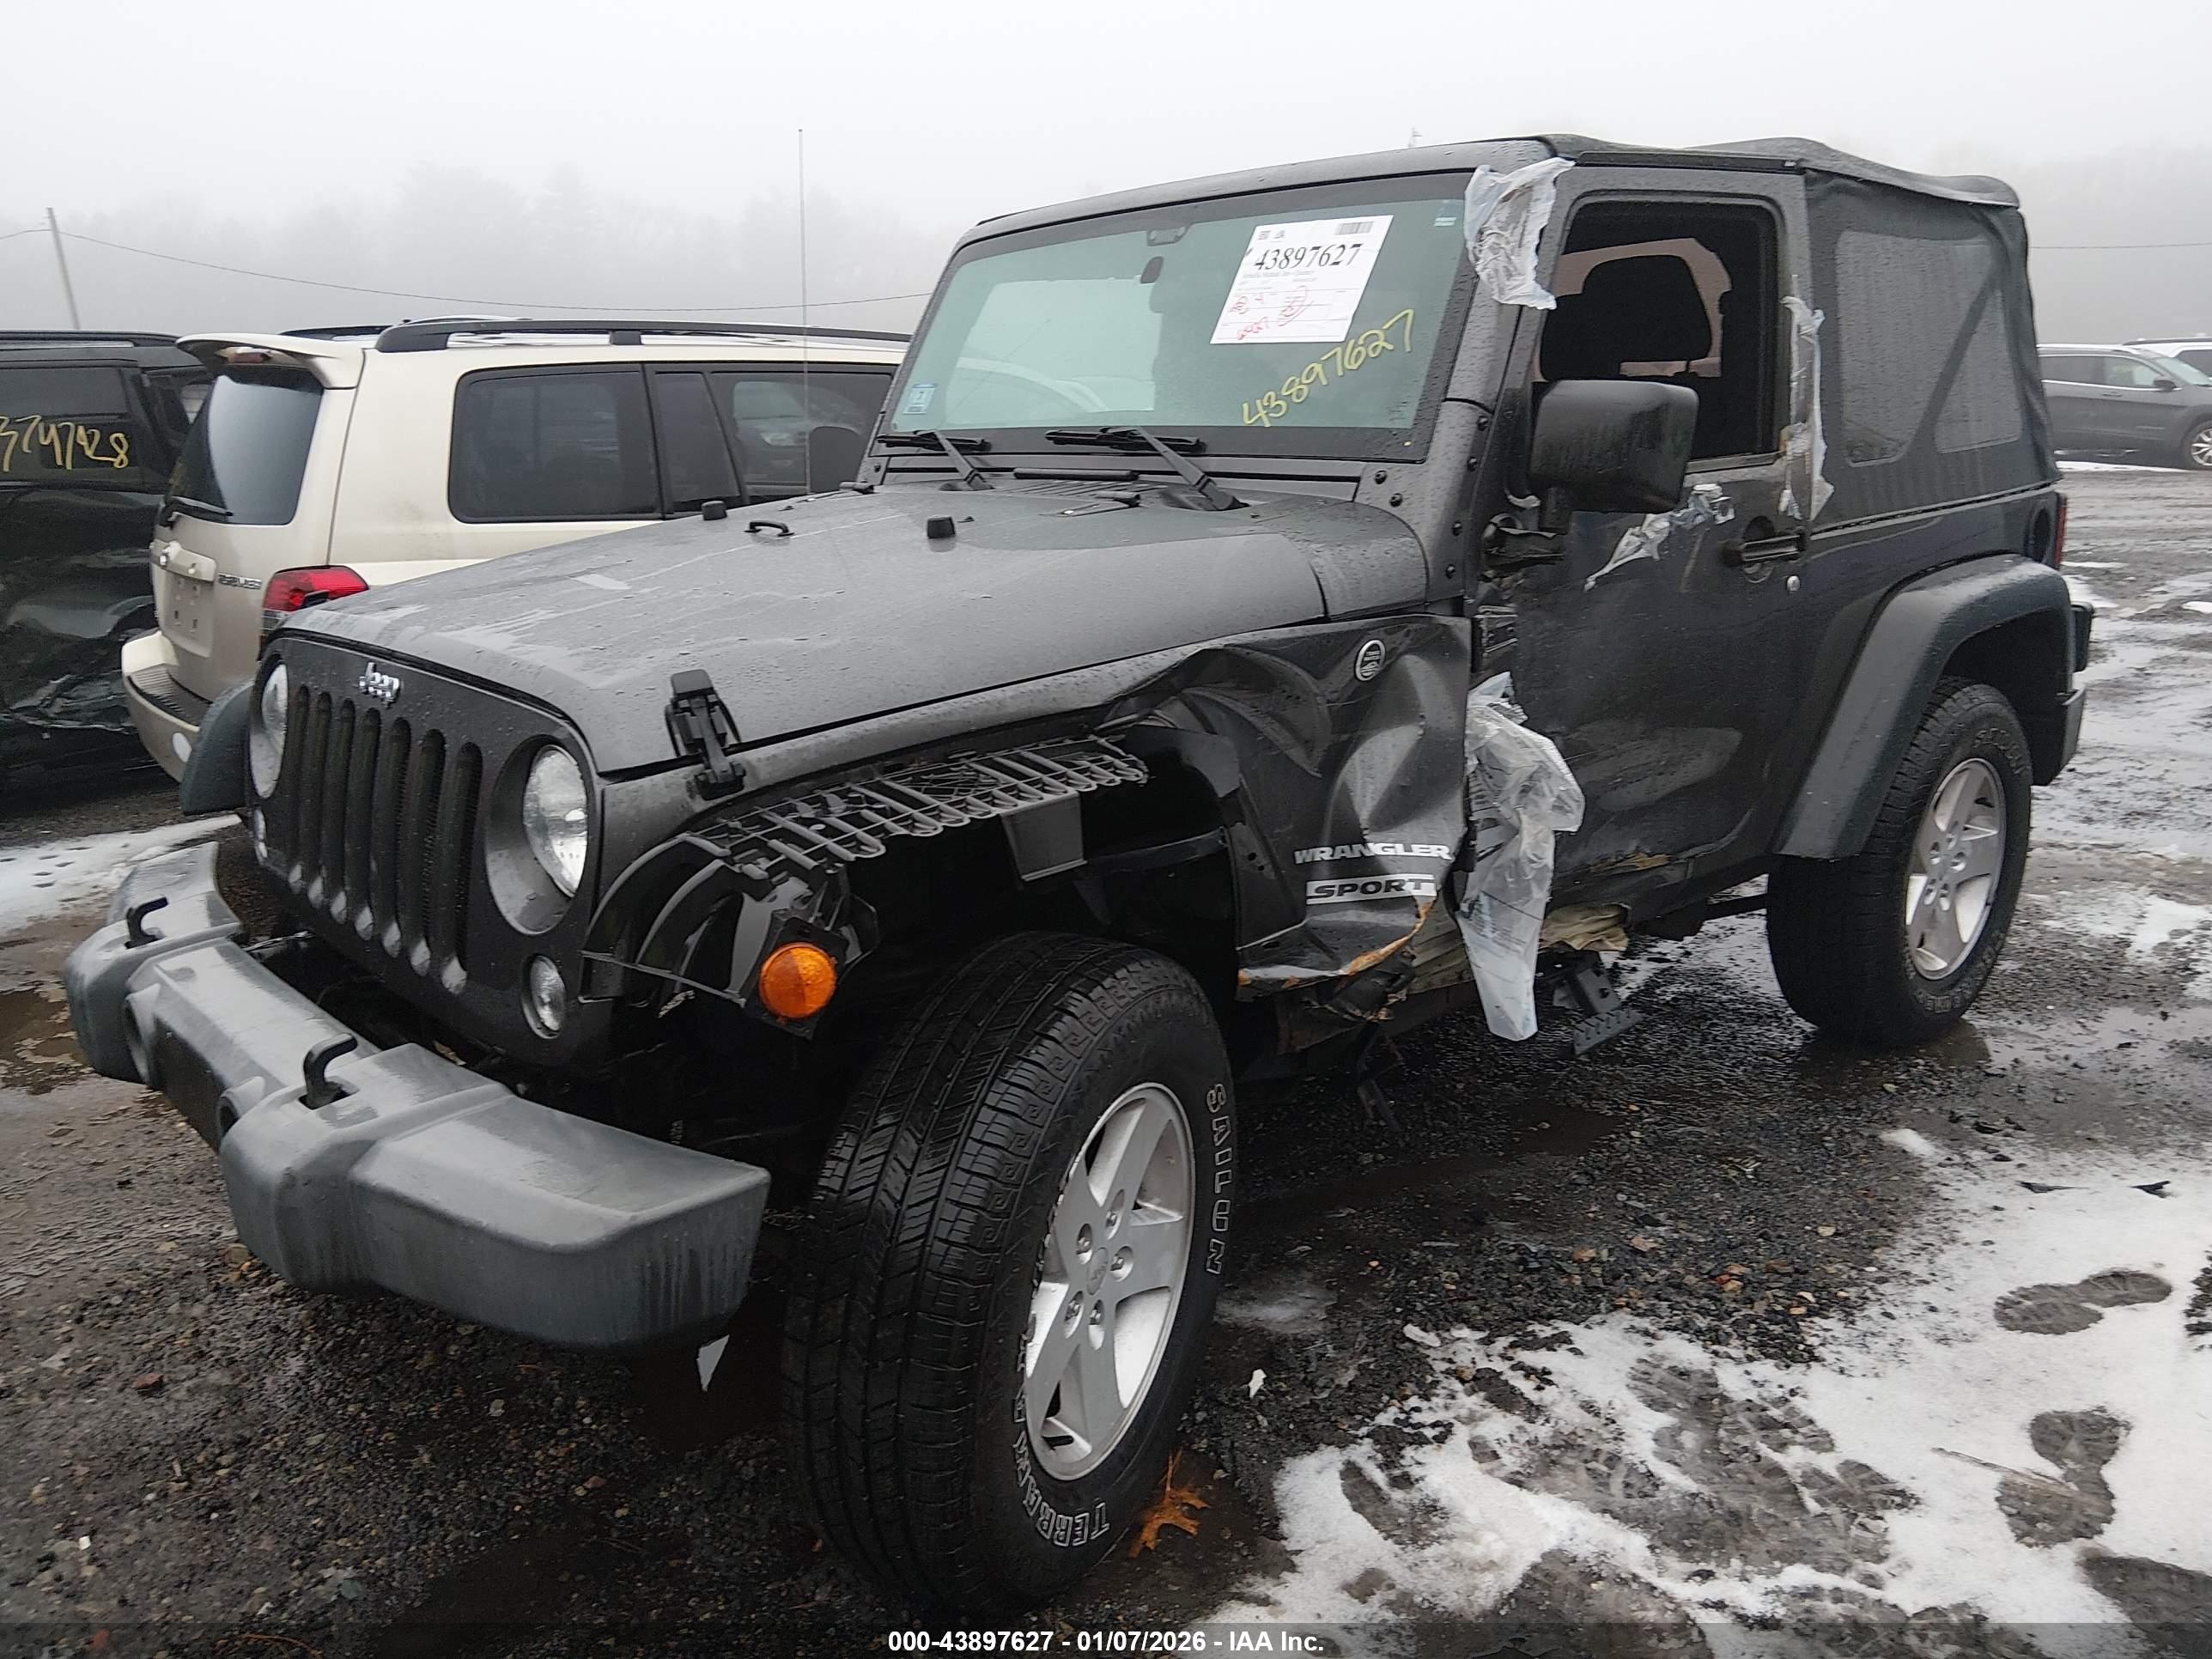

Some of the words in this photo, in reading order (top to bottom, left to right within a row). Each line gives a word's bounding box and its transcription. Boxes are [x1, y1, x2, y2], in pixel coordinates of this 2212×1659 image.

[1254, 243, 1362, 270] 43897627
[1242, 308, 1414, 428] 43897627
[359, 661, 401, 704] Jeep
[1293, 842, 1455, 865] WRANGLER
[1307, 878, 1437, 900] SPORT
[1206, 1084, 1232, 1274] SAILUN
